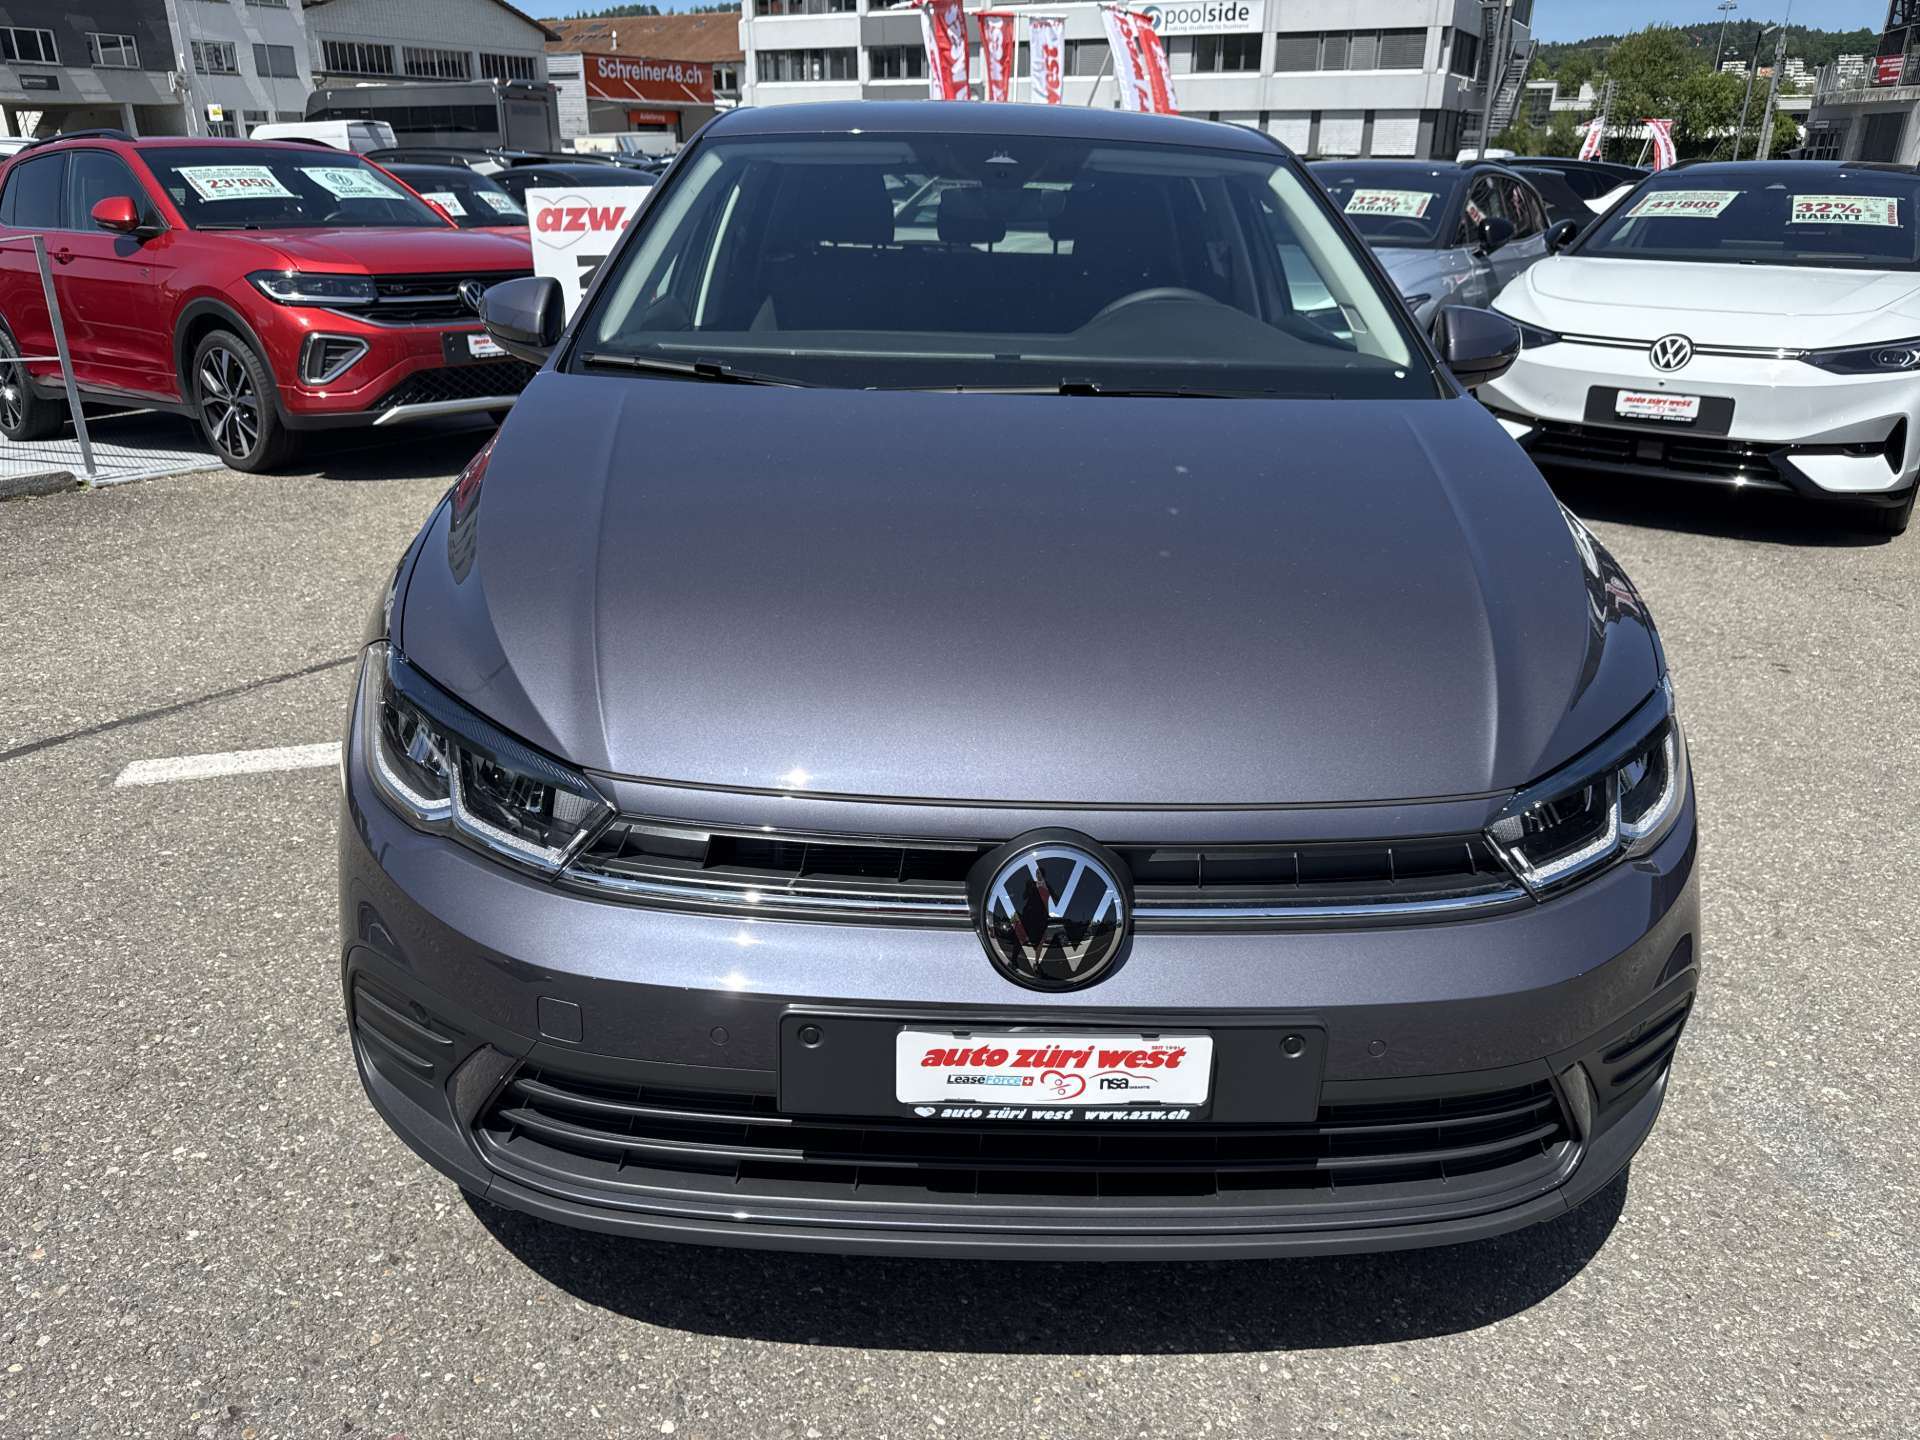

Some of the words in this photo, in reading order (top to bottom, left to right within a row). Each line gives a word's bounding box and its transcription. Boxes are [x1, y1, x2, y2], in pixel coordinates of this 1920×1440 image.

[1165, 2, 1249, 31] poolside
[598, 57, 703, 84] Schreiner48.ch
[1348, 204, 1398, 213] RABATT
[1651, 201, 1720, 209] 44'800
[1796, 202, 1862, 214] 32%
[1795, 213, 1863, 221] RABATT
[920, 1044, 1008, 1068] auto
[1009, 1044, 1096, 1069] züri
[1097, 1046, 1187, 1069] west
[946, 1074, 1022, 1086] LeaseForce
[1099, 1076, 1129, 1090] nsa
[940, 1107, 983, 1119] auto
[986, 1106, 1026, 1120] züri
[1031, 1109, 1074, 1120] west
[1085, 1109, 1191, 1121] www.azw.ch
